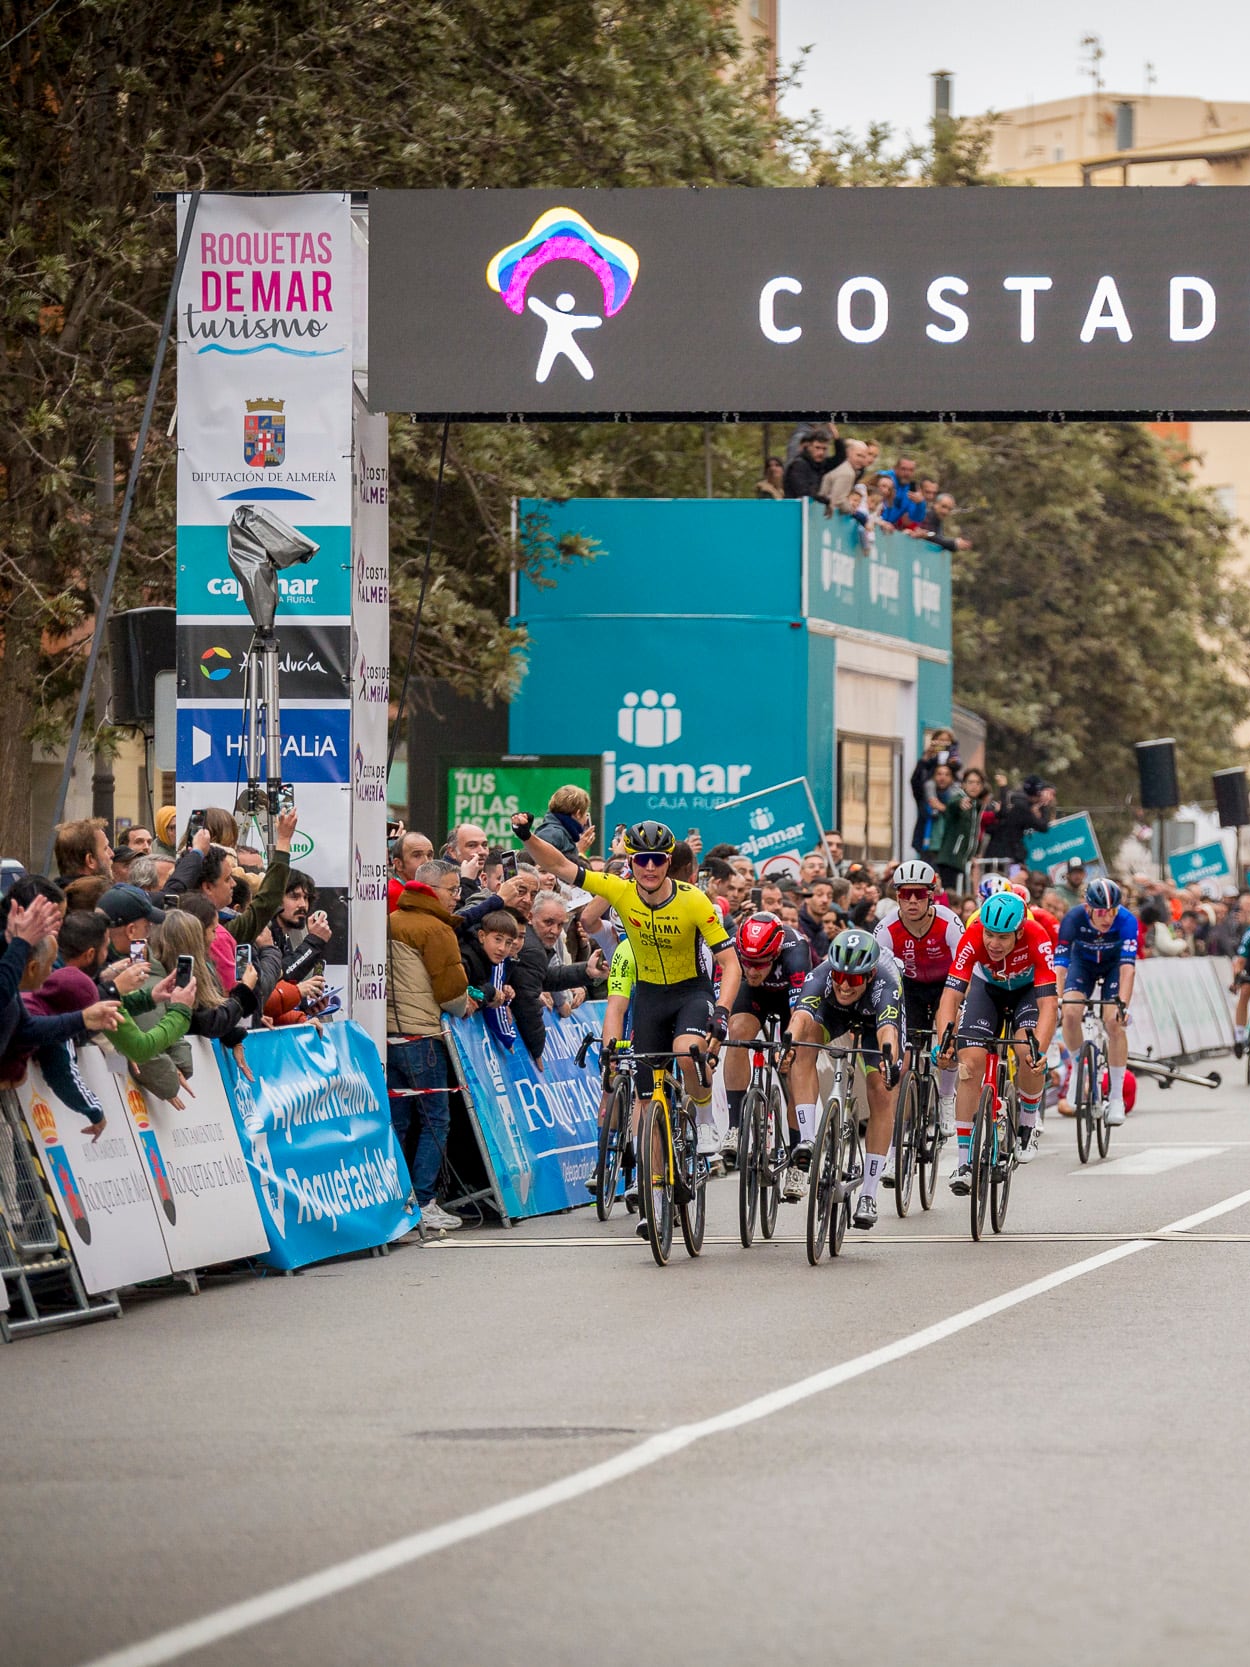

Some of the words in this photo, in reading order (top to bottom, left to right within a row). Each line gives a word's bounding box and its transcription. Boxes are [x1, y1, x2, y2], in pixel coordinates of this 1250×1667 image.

[201, 232, 332, 266] ROQUETAS
[183, 303, 328, 338] turismo
[192, 470, 264, 482] DIPUTACIÓN
[267, 471, 281, 482] DE
[285, 470, 336, 482] ALMERÍA
[454, 772, 496, 793] TUS
[455, 795, 519, 816] PILAS
